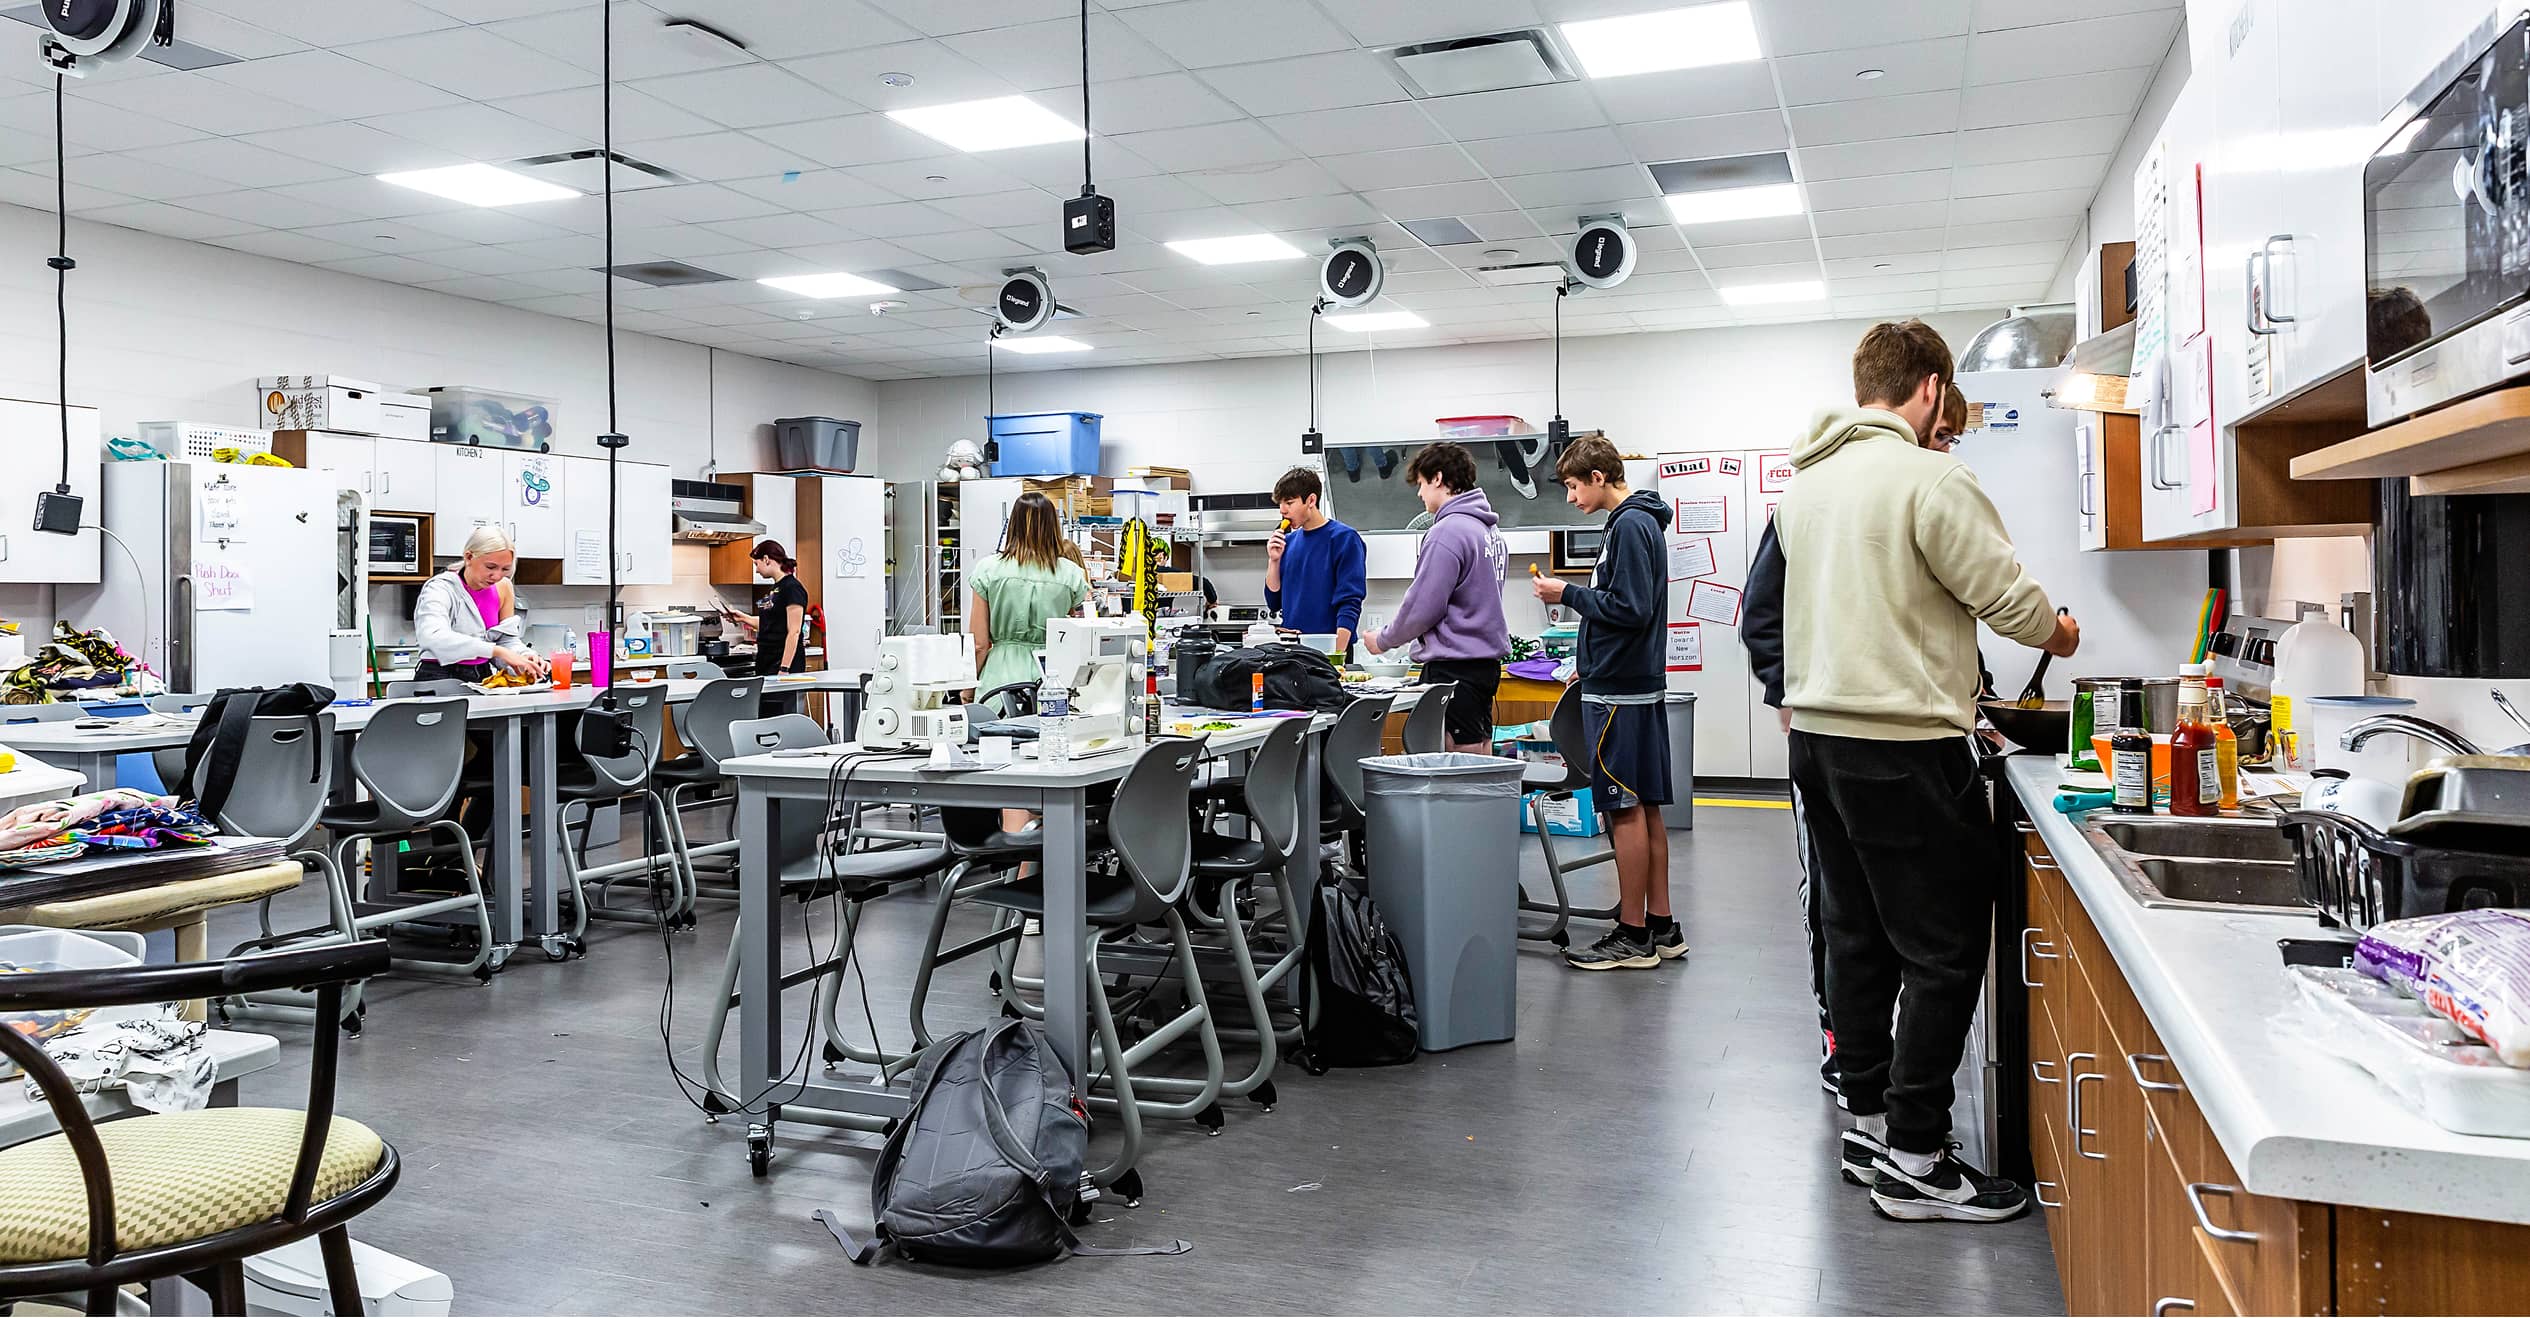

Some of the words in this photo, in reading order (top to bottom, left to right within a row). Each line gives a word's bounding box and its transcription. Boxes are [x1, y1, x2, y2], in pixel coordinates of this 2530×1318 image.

[456, 447, 478, 457] KITCHEN
[479, 449, 483, 458] 2
[1664, 460, 1706, 474] What
[1723, 461, 1738, 472] is
[195, 563, 217, 579] Push
[204, 581, 233, 597] Shut
[1058, 631, 1066, 643] 7
